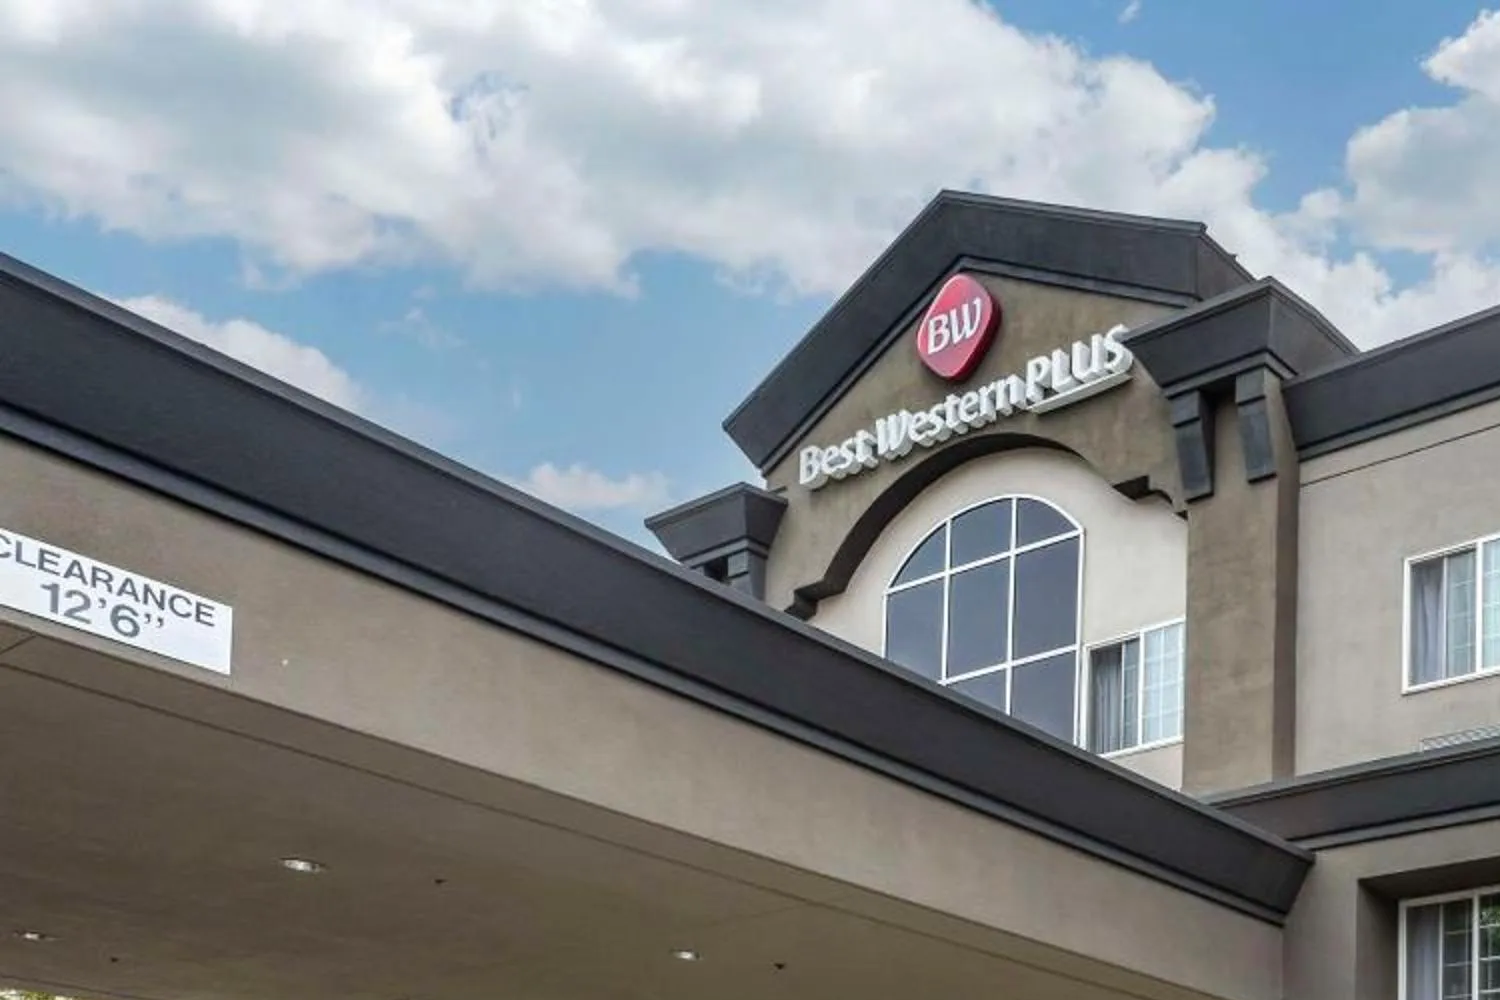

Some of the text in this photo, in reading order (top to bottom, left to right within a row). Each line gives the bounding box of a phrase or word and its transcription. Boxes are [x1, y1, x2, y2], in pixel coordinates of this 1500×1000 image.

[928, 297, 982, 354] BW
[799, 324, 1135, 490] Best Western PLUS
